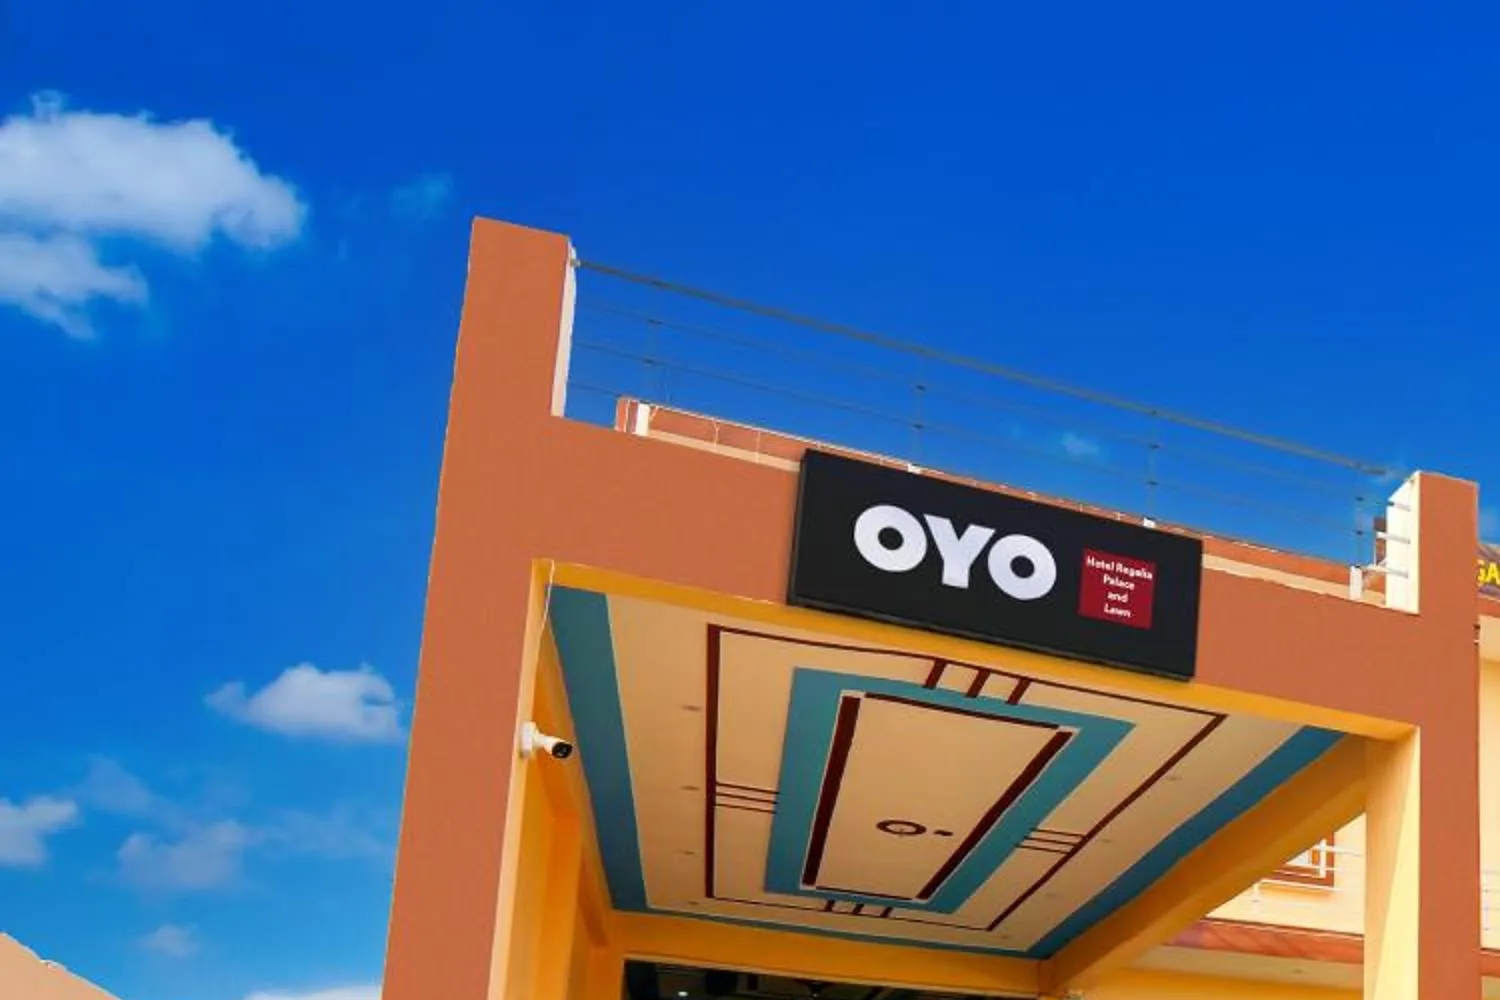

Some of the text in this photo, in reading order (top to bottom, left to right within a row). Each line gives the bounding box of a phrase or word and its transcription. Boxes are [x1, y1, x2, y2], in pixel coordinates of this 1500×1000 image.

[853, 504, 1057, 601] OYO
[1086, 555, 1153, 580] Hotel Regalia
[1103, 573, 1135, 590] Palace
[1107, 591, 1129, 603] and
[1103, 603, 1131, 618] Lawn
